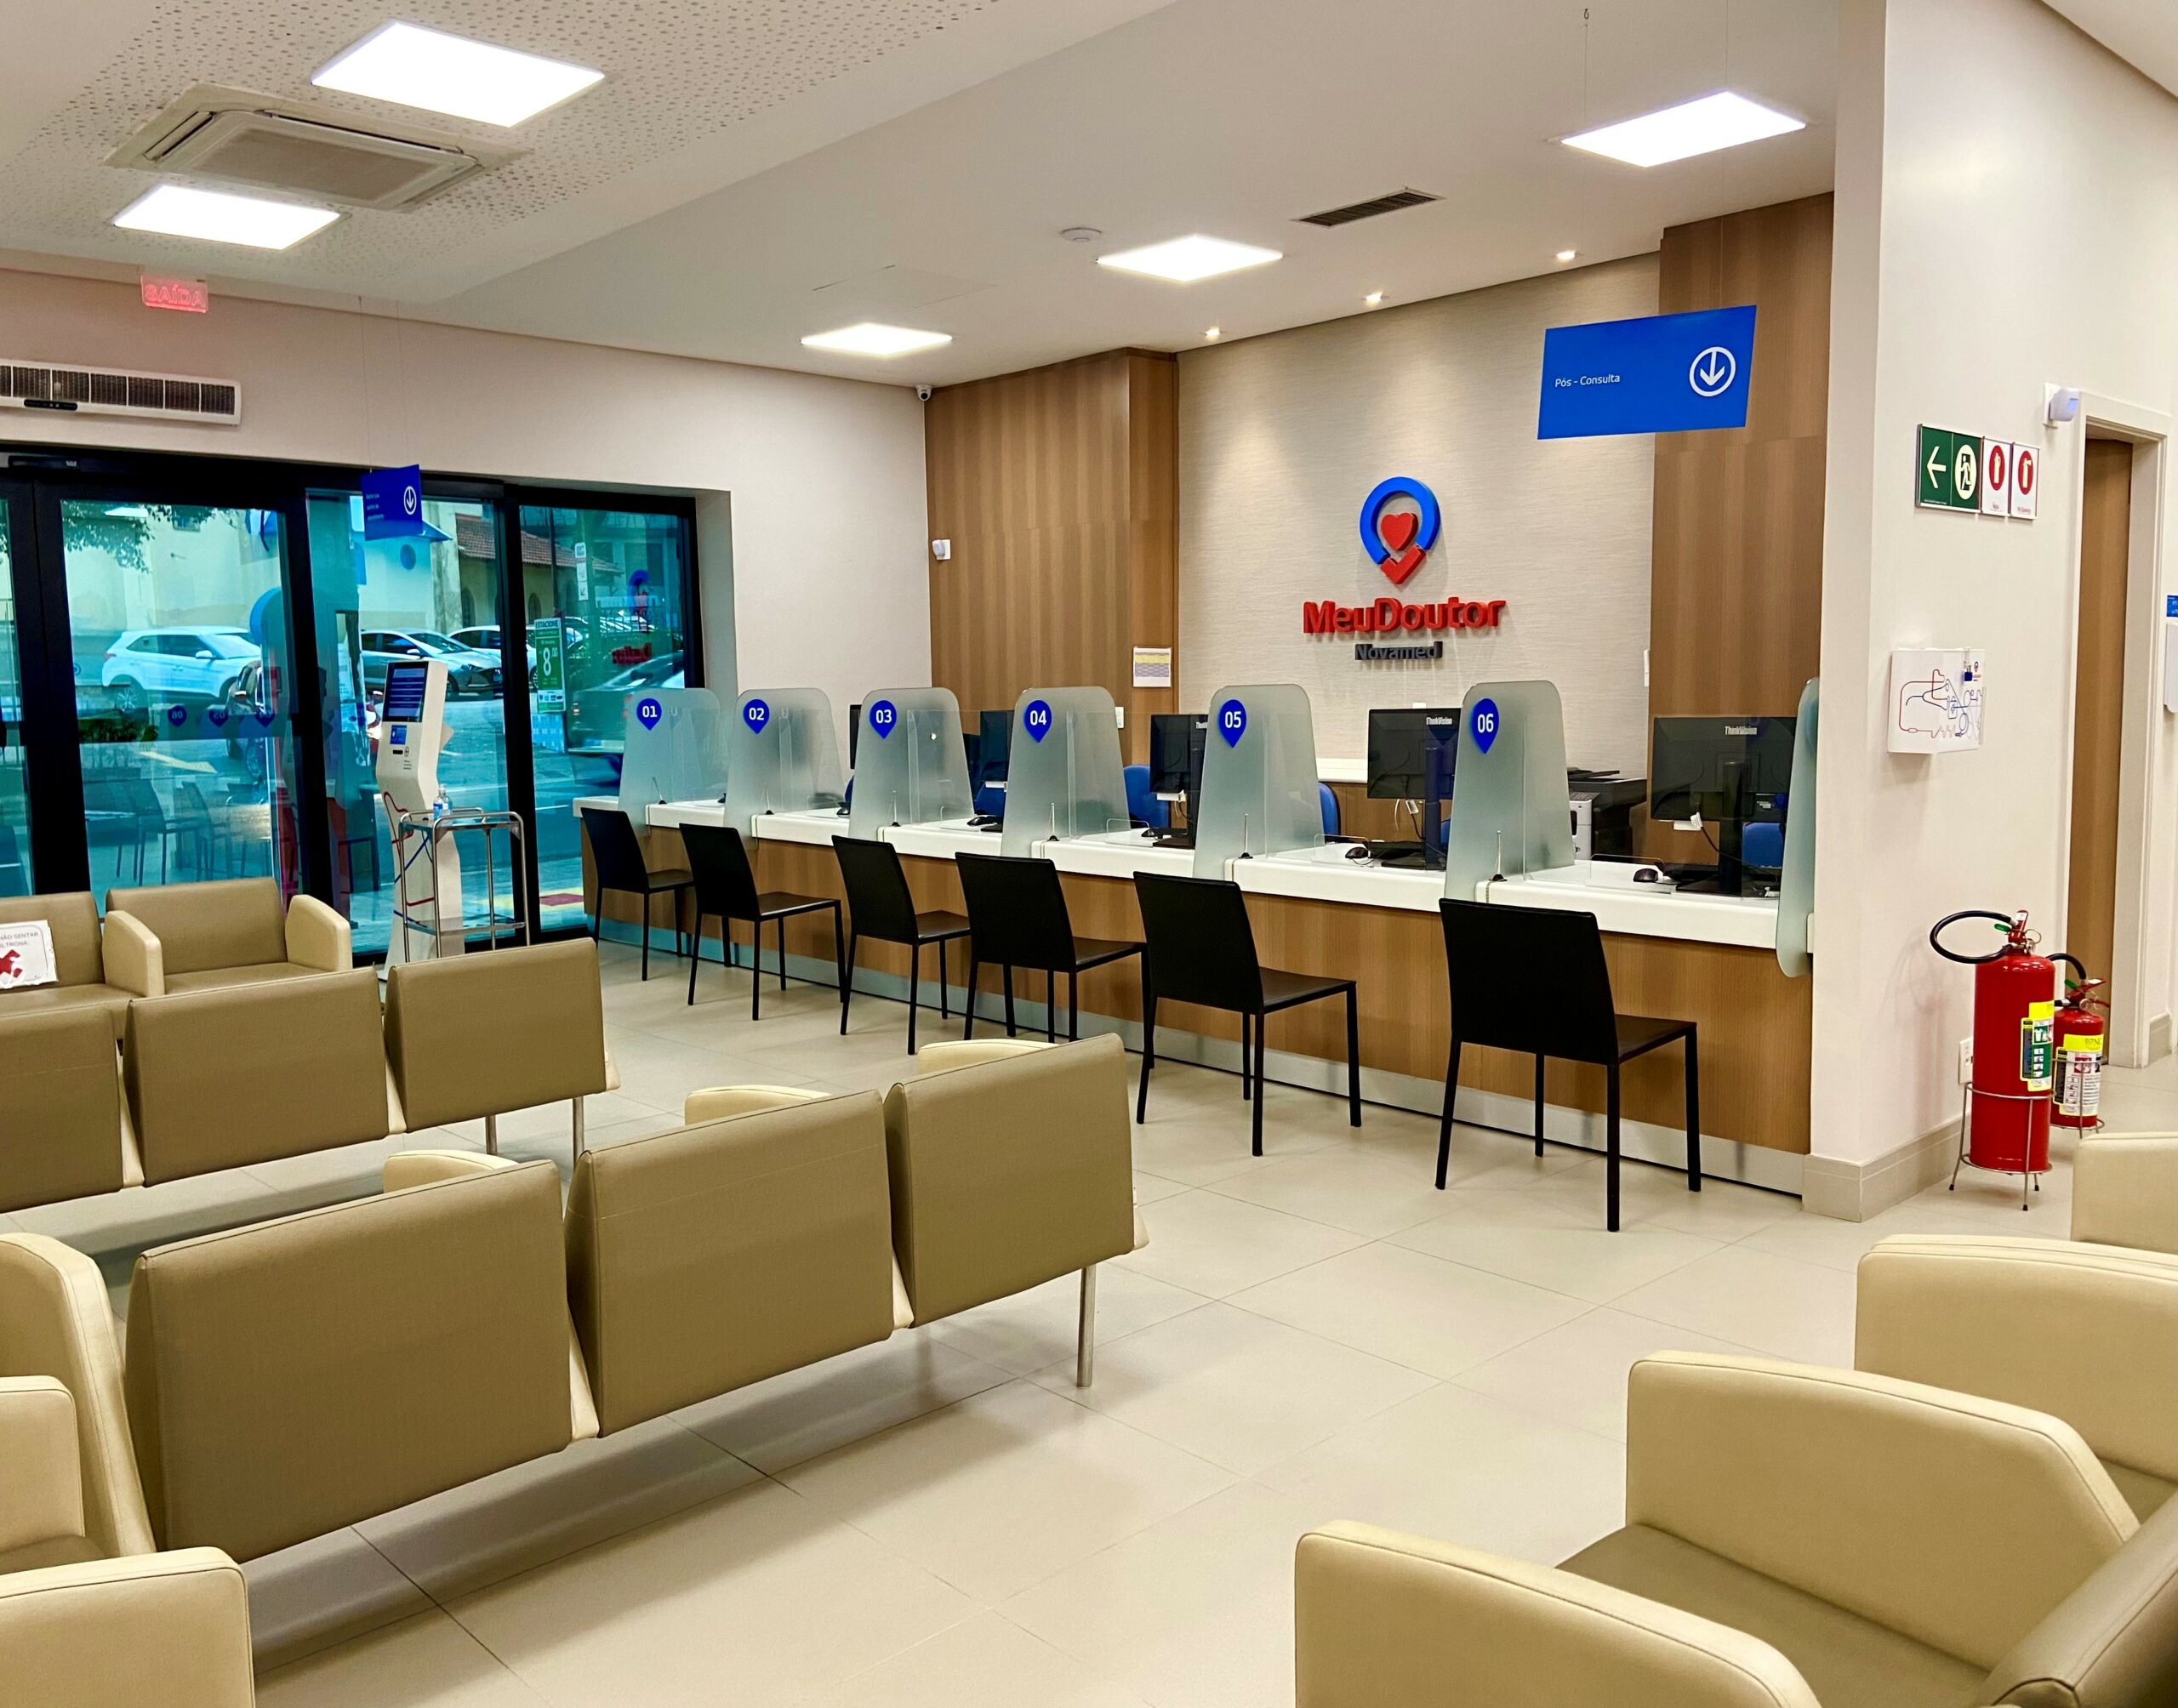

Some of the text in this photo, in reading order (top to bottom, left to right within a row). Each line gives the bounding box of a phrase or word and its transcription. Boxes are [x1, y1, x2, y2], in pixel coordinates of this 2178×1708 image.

[145, 284, 206, 307] SAÍDA
[1554, 378, 1571, 388] Pós
[1580, 374, 1620, 385] Consulta
[1303, 596, 1506, 634] MeuDoutor
[1354, 640, 1444, 661] Novamed
[641, 705, 658, 718] 01
[749, 708, 765, 720] 02
[875, 709, 892, 724] 03
[1029, 710, 1047, 726] 04
[1225, 711, 1242, 728] 05
[1477, 713, 1494, 733] 06
